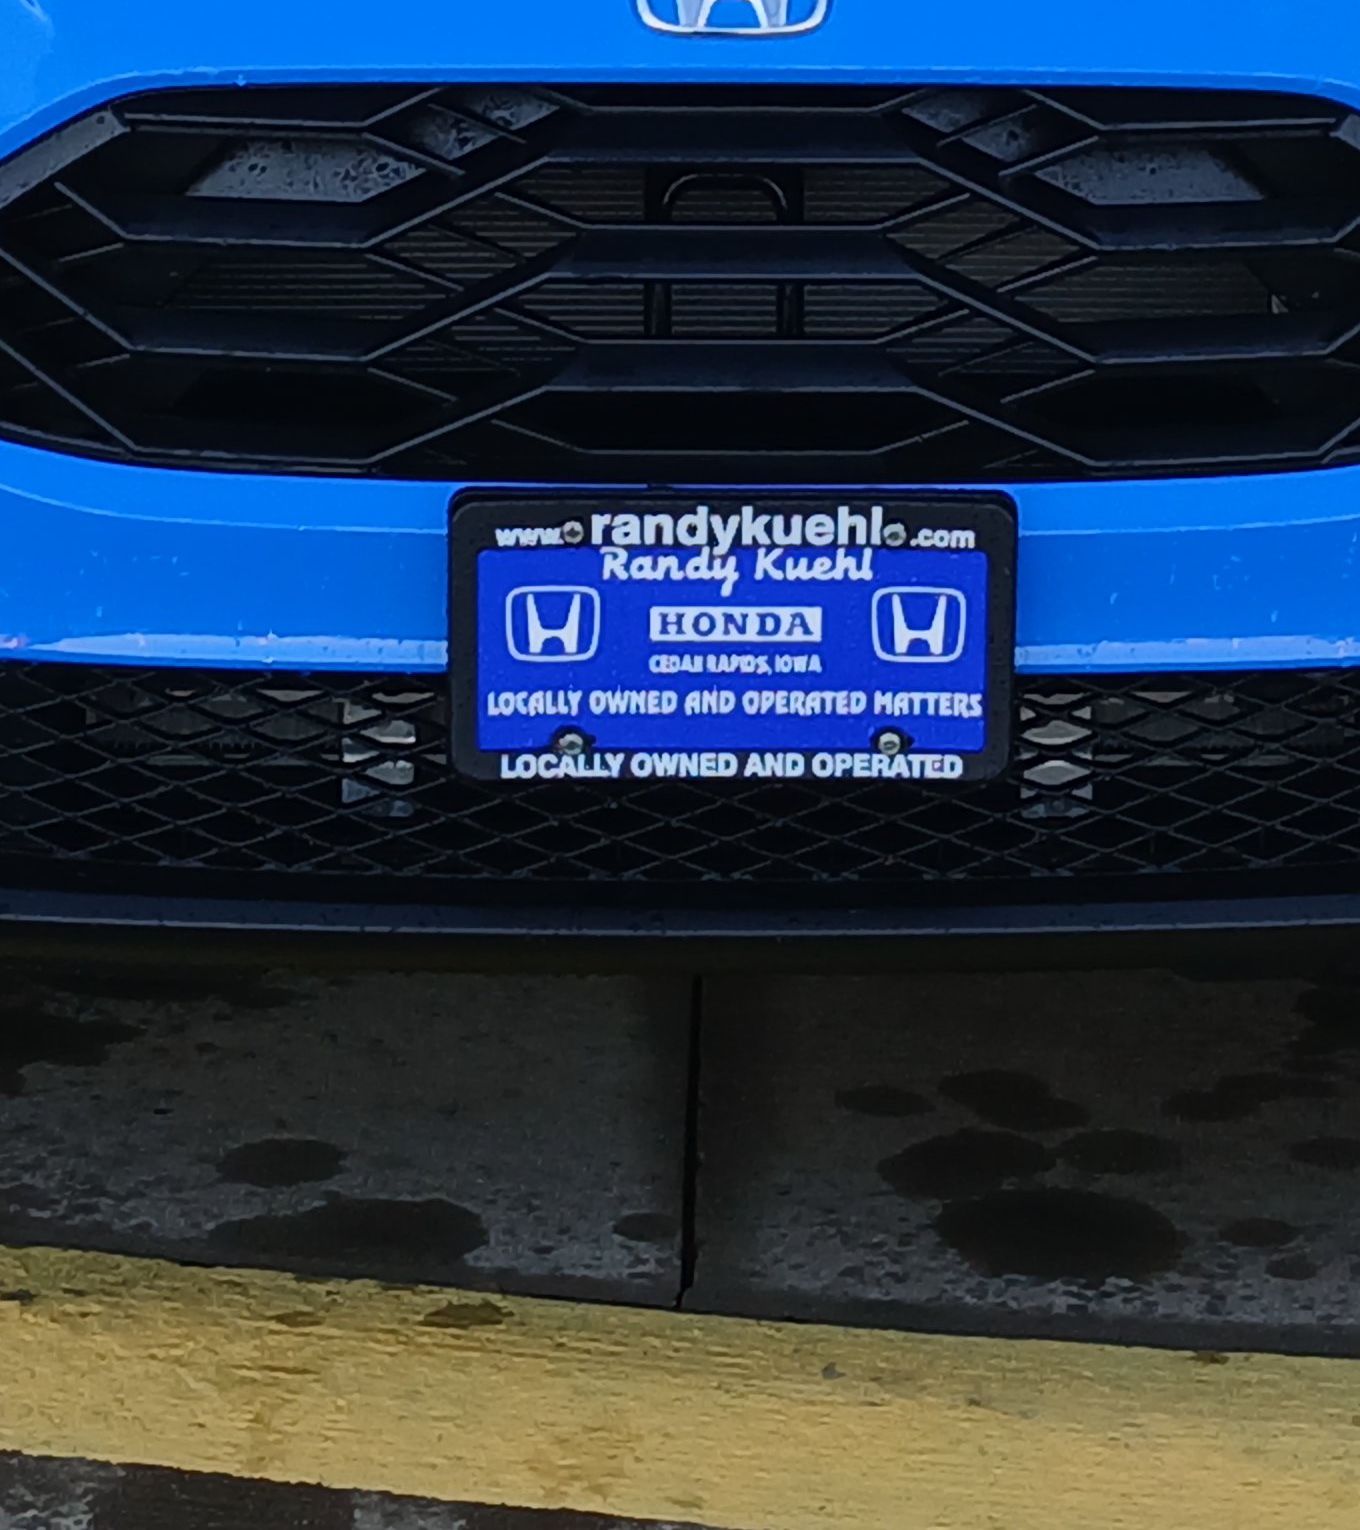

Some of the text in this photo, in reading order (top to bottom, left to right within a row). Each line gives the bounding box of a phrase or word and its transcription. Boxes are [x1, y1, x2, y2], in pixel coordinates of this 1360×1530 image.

[591, 505, 883, 555] randykuehl
[600, 545, 874, 597] Randy Kuehl
[658, 612, 814, 637] HONDA
[775, 654, 823, 674] IOWA
[487, 689, 983, 718] LOCALLY OWNED AND OPERATED MATTERS
[500, 752, 964, 779] LOCALLY OWNED AND OPERATED
